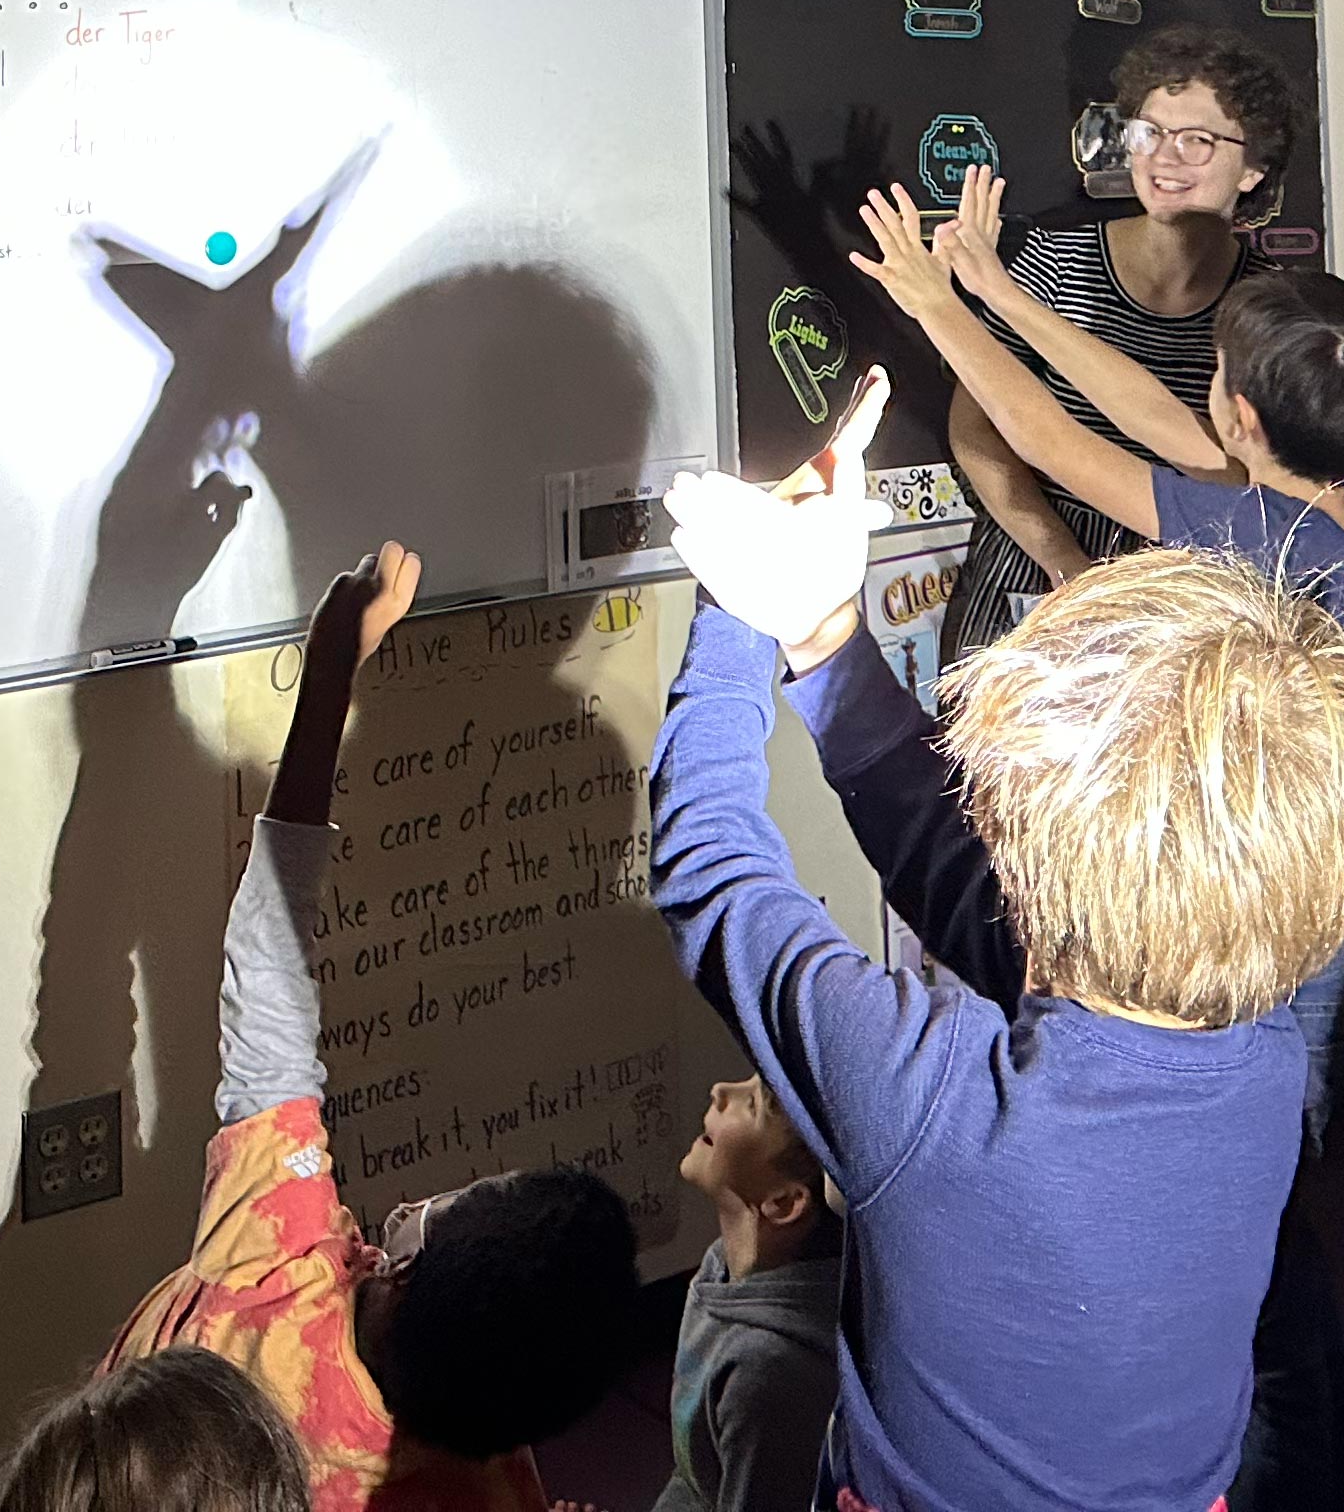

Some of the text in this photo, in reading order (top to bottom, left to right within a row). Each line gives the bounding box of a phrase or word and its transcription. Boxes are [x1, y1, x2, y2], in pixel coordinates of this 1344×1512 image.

[66, 7, 177, 66] der Tiger
[932, 140, 988, 165] Clean-Up
[788, 314, 830, 352] Lights
[378, 607, 573, 674] Hive Rules
[373, 753, 434, 787] care
[444, 719, 475, 770] of
[379, 755, 649, 850] care of each other
[313, 827, 648, 939] ake care of the things
[354, 937, 406, 976] our
[419, 901, 544, 956] classroom
[556, 868, 600, 918] and
[605, 860, 648, 905] scho
[320, 1011, 392, 1056] ways
[408, 980, 440, 1029] do
[454, 976, 509, 1025] your
[360, 1116, 432, 1180] break
[481, 1108, 520, 1150] you
[524, 1079, 558, 1124] fix
